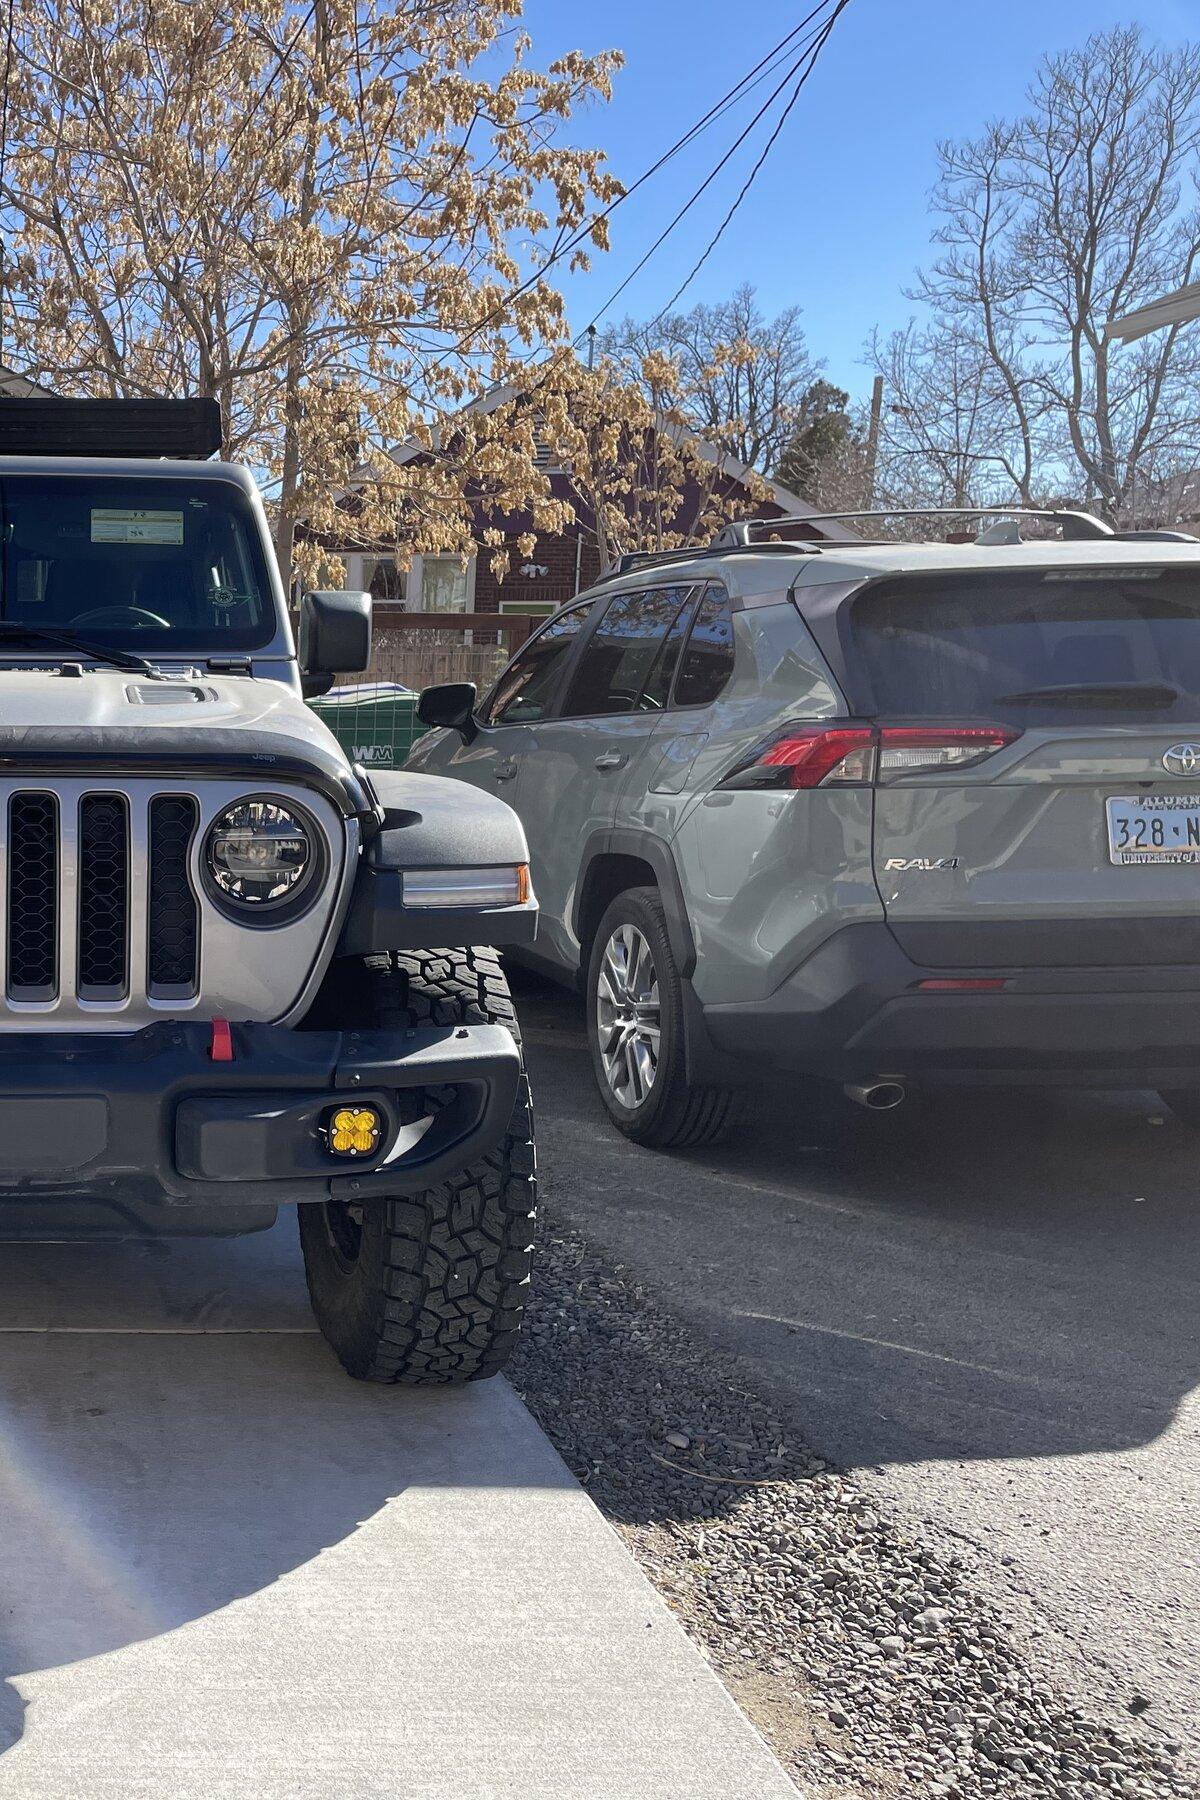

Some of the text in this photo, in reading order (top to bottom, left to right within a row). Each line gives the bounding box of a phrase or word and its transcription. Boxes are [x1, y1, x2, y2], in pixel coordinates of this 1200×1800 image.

[252, 752, 276, 763] Jeep
[351, 745, 394, 761] WM
[1122, 852, 1182, 864] UNIVERSITY
[884, 858, 960, 871] RAV4
